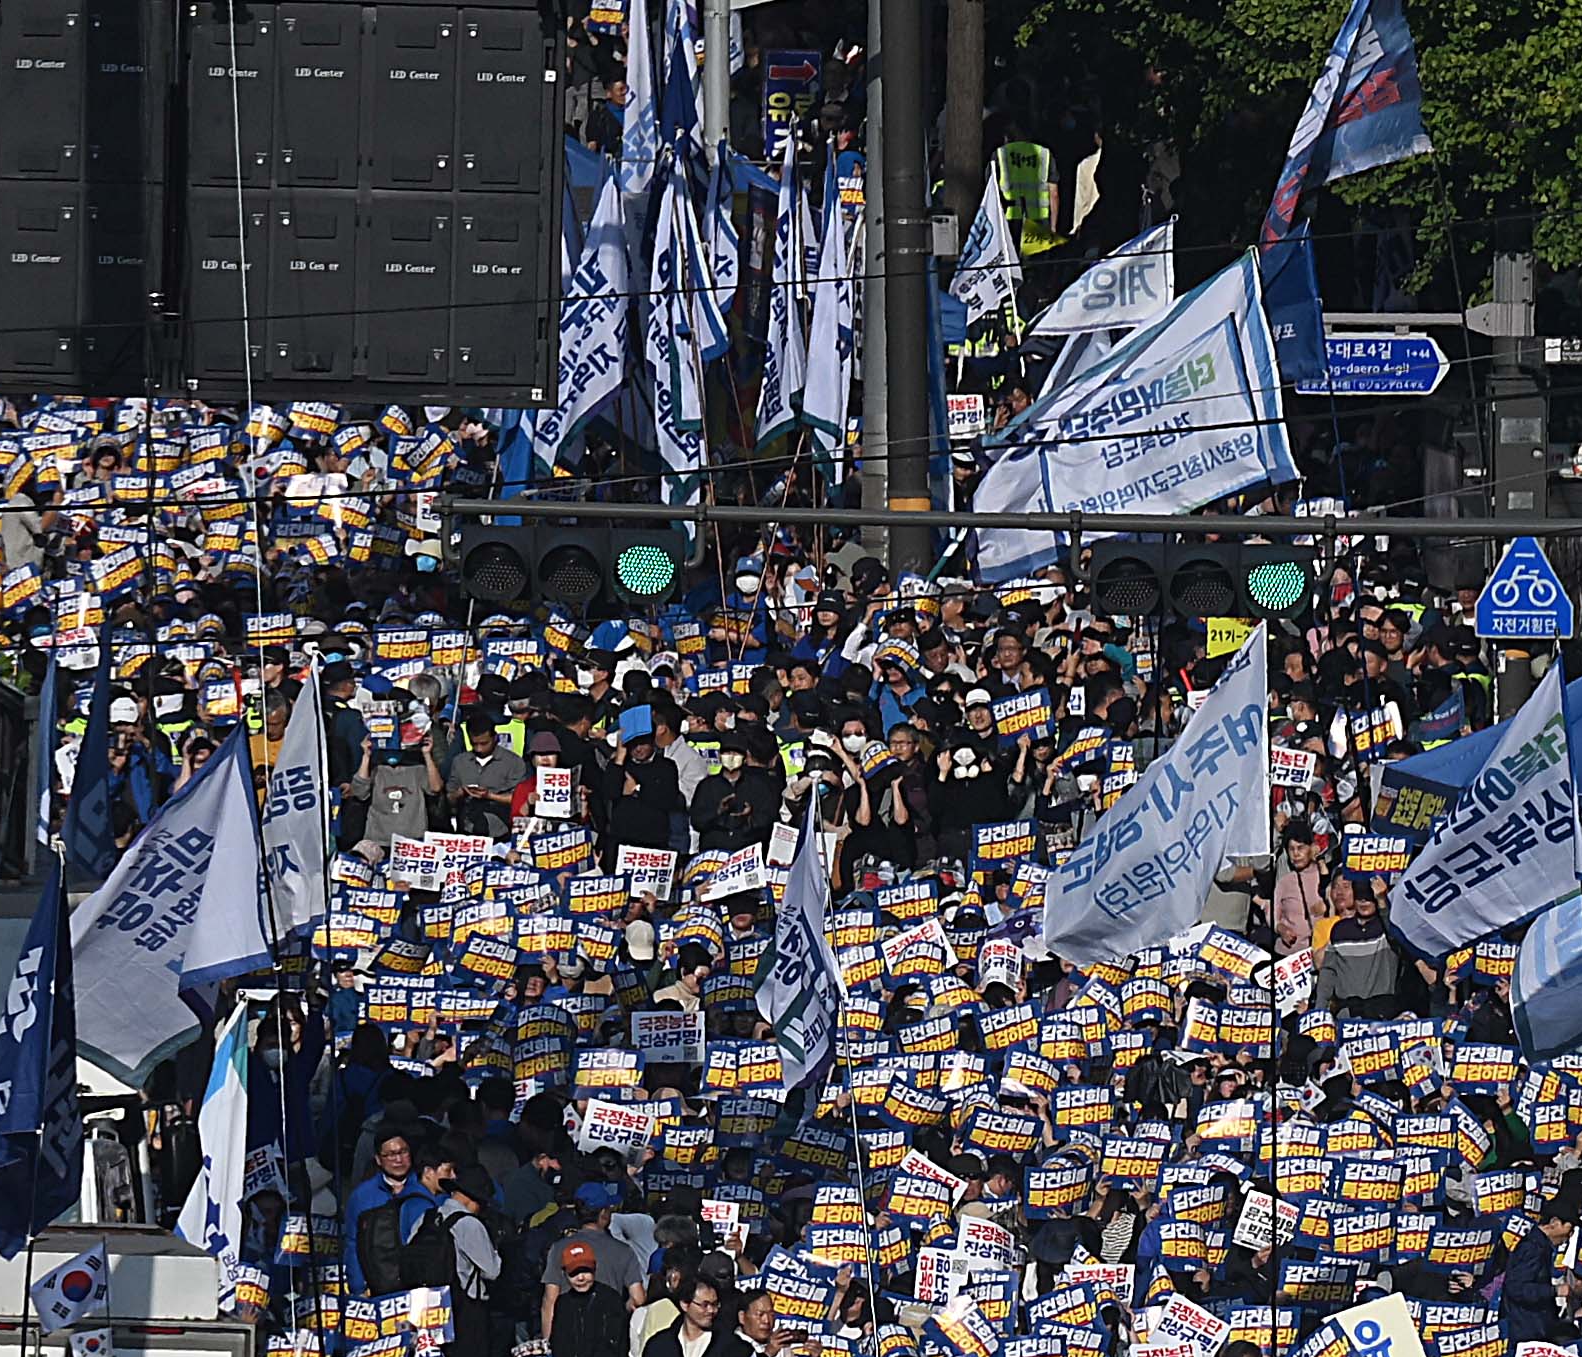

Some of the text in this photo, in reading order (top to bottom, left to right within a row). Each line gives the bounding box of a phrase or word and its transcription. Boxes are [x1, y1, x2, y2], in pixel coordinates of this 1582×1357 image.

[17, 60, 66, 69] LED Center
[1492, 617, 1556, 633] 자전거횡단
